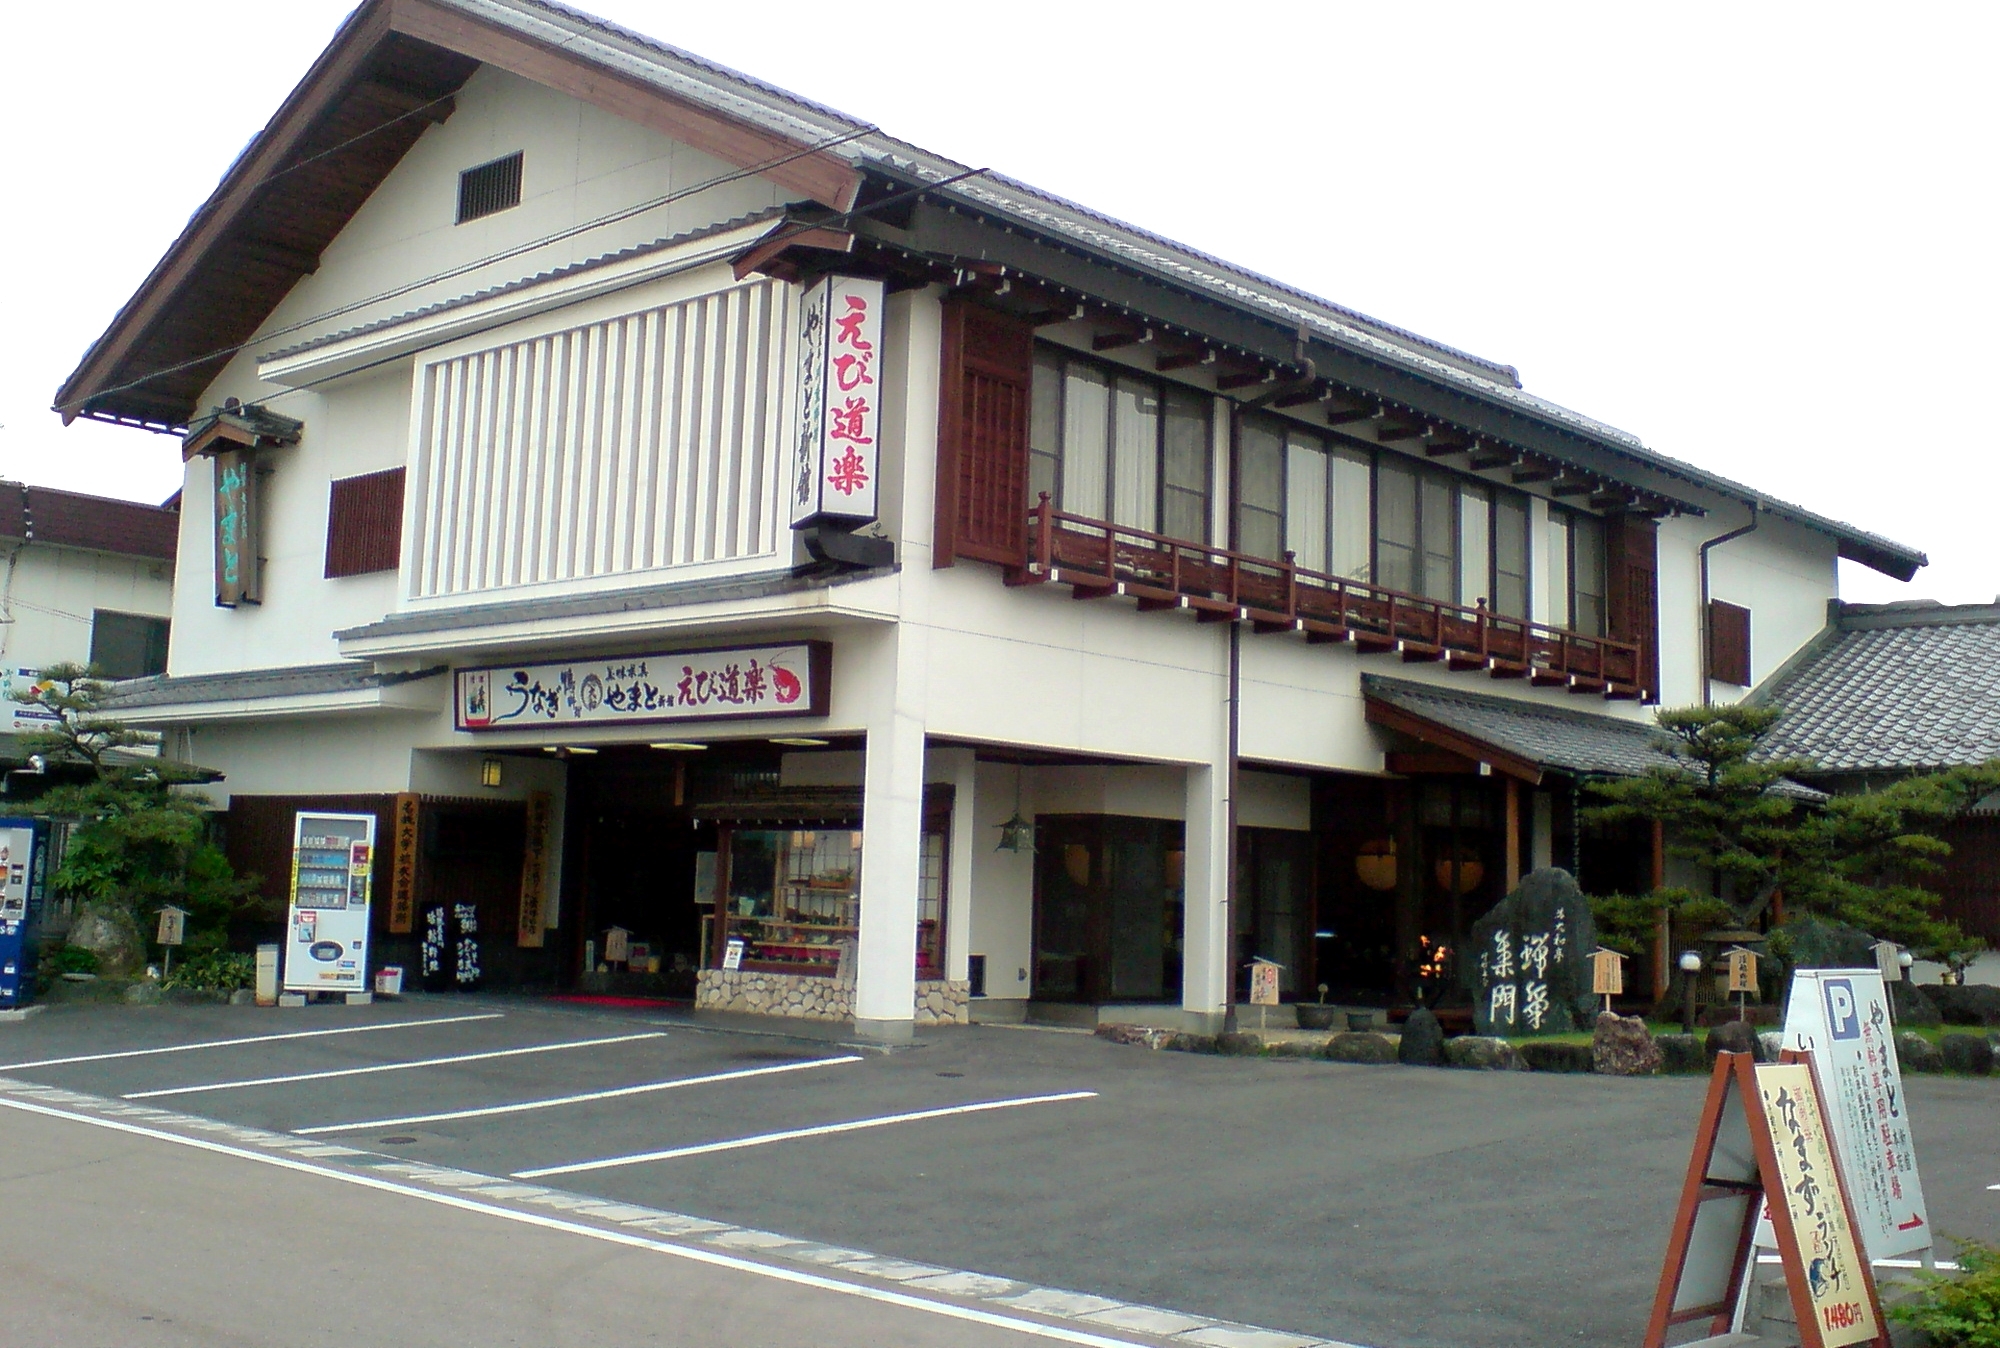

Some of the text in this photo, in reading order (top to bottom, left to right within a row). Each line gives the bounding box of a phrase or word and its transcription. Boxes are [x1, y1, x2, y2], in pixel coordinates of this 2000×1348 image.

[828, 294, 874, 496] えび道楽
[219, 465, 241, 584] やまと
[491, 670, 562, 718] うなぎ
[677, 658, 768, 706] えび道楽
[1828, 985, 1854, 1034] P
[1869, 999, 1899, 1118] やまと
